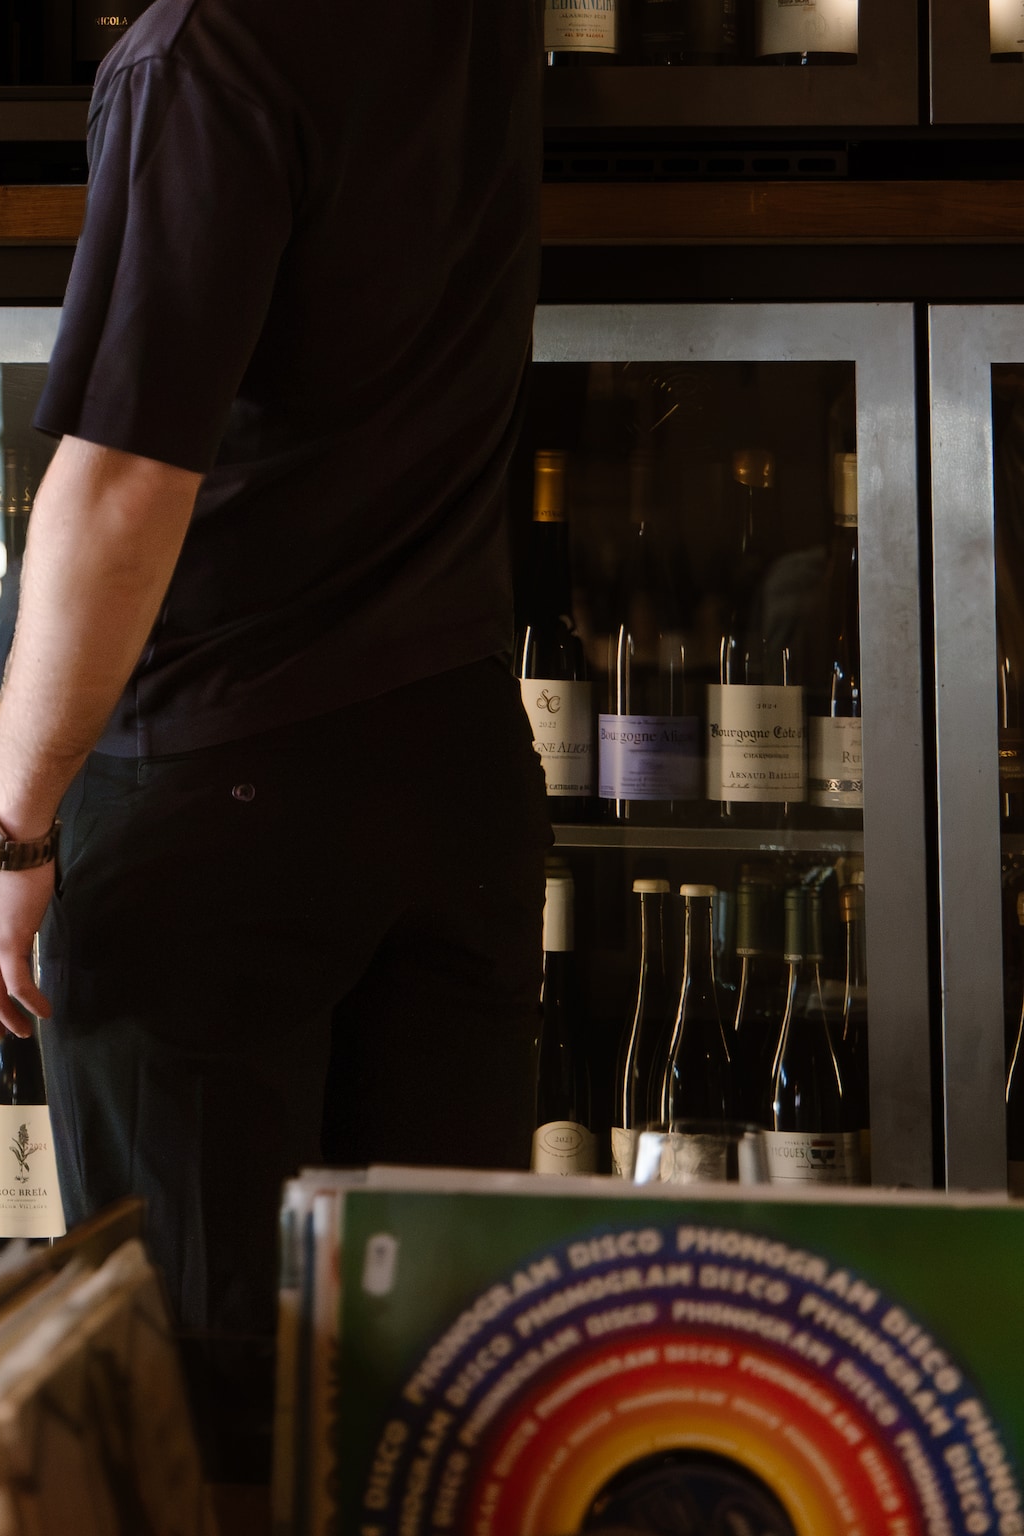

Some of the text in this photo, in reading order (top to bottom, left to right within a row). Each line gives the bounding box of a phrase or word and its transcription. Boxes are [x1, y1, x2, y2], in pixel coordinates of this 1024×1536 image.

[601, 728, 657, 745] Bougogne
[710, 723, 770, 743] Bourgogne
[729, 771, 766, 779] ARNAUD
[568, 1227, 663, 1270] DISCO
[677, 1225, 881, 1314] PHONOGRAM
[880, 1306, 962, 1395] DISCO
[443, 1334, 514, 1408] DISCO
[513, 1264, 694, 1339] PHONOGRAM
[698, 1263, 790, 1305] DISCO
[798, 1292, 952, 1438] PHONOGRAM
